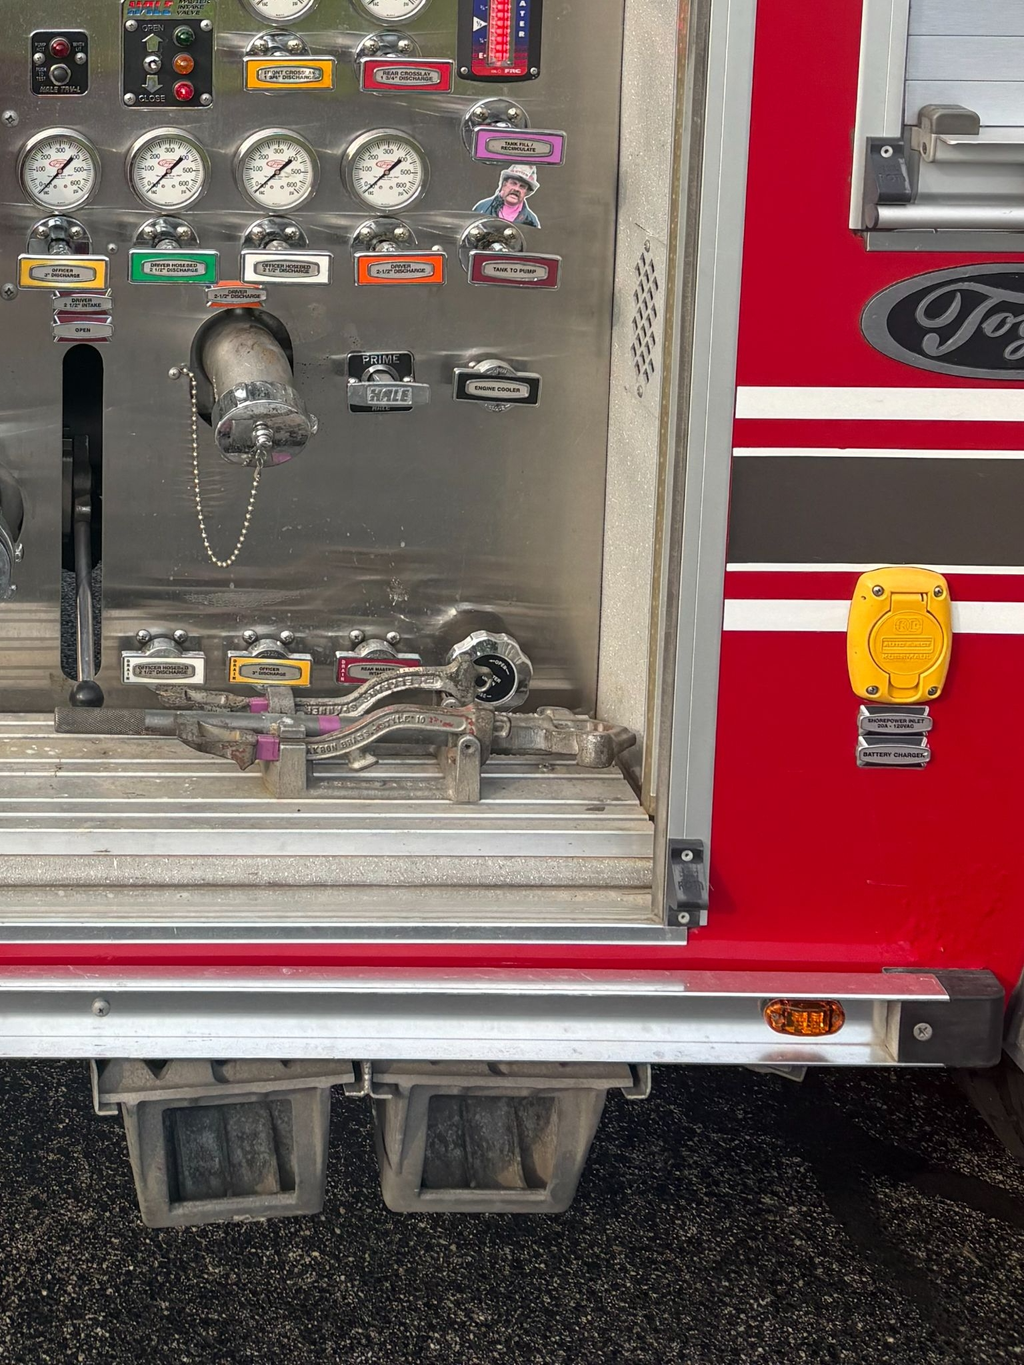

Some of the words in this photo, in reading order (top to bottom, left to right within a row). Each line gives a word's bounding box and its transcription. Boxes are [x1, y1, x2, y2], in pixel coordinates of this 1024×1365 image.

[127, 0, 174, 16] HALE
[362, 354, 400, 365] PRIME
[368, 387, 411, 403] HALE
[306, 744, 338, 756] AKRON
[416, 714, 426, 724] 10
